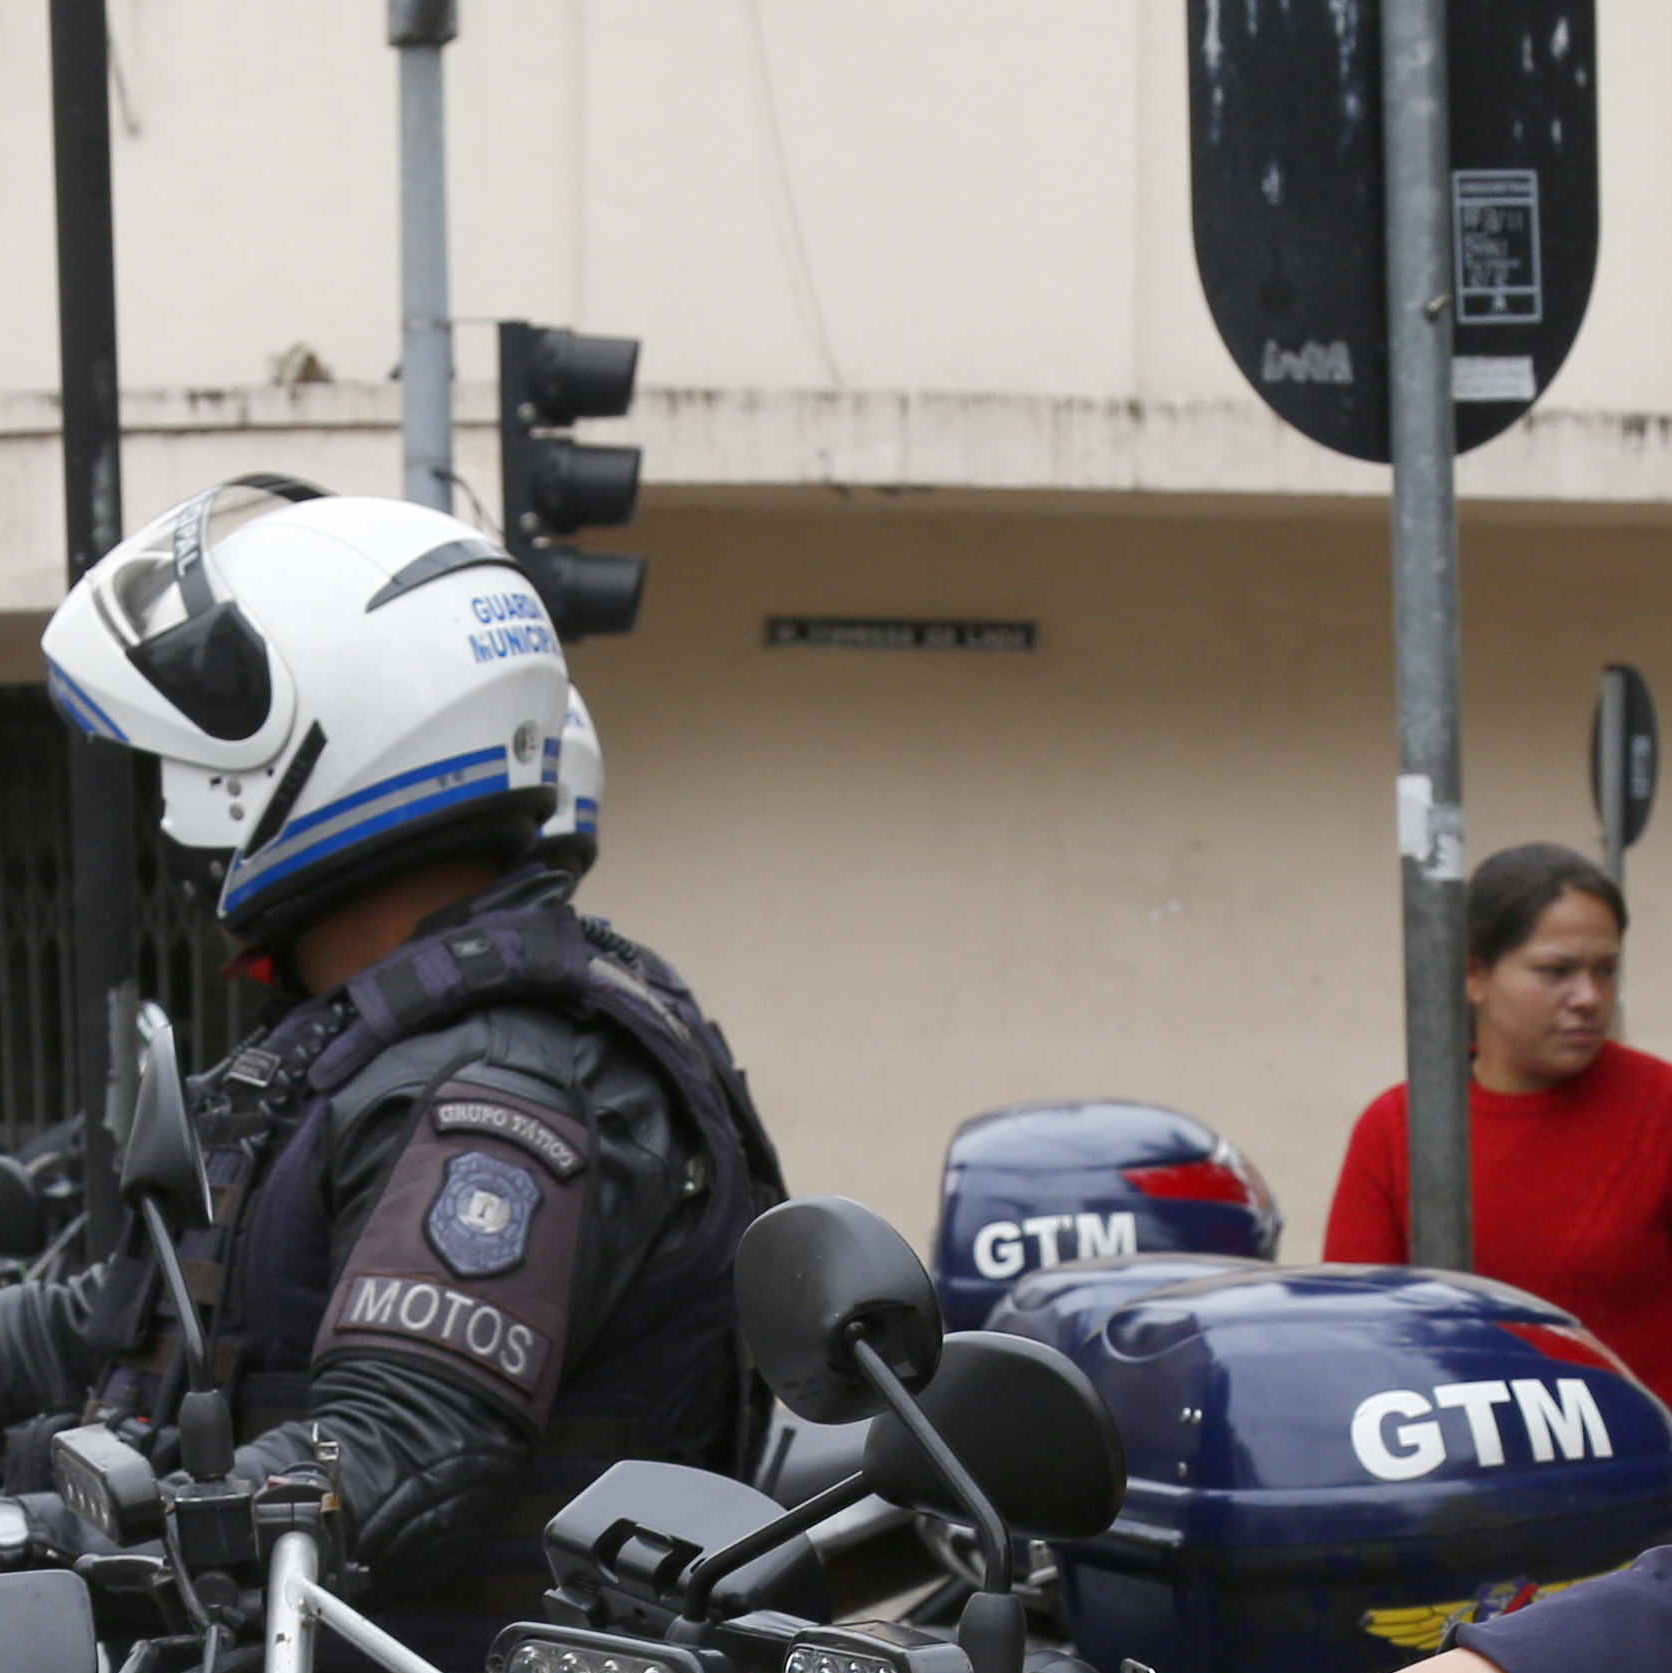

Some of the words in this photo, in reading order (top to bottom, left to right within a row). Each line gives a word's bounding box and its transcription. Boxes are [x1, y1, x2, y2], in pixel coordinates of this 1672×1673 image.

[438, 1103, 508, 1127] GRUPO
[973, 1211, 1138, 1280] GTM
[350, 1278, 533, 1376] MOTOS
[1350, 1378, 1614, 1482] GTM
